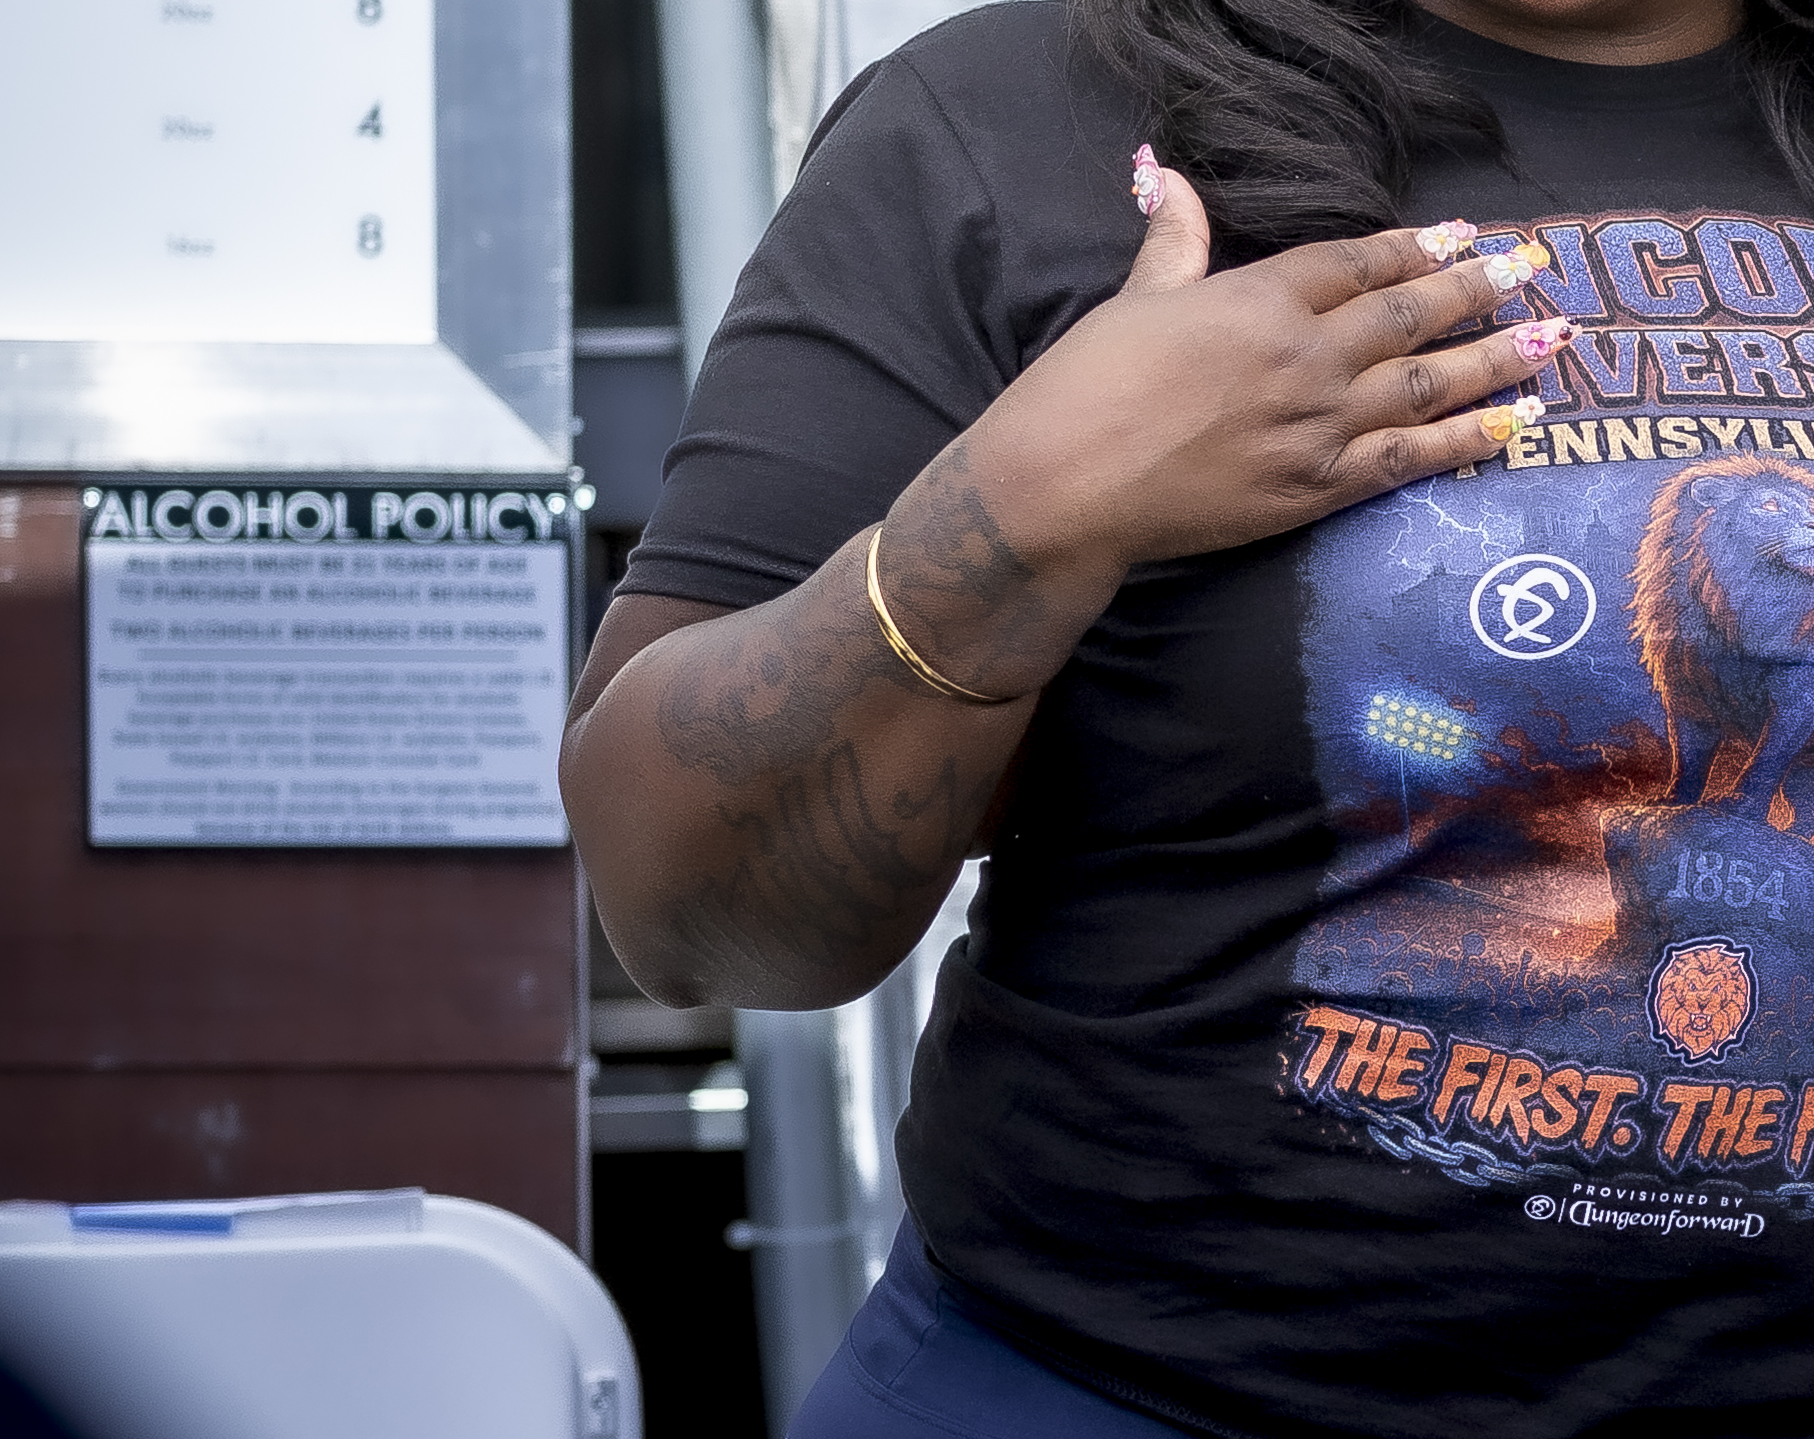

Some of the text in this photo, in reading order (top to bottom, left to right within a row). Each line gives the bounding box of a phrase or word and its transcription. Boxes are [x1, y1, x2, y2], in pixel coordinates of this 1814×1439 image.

[357, 101, 384, 139] 4
[356, 214, 384, 257] 8
[92, 490, 556, 544] ALCOHOL POLICY
[1666, 848, 1790, 922] 1854
[1303, 1006, 1435, 1104] THE
[1433, 1041, 1632, 1146] FIRST.
[1661, 1080, 1786, 1162] THE
[1572, 1183, 1744, 1209] PROVISIONED BY
